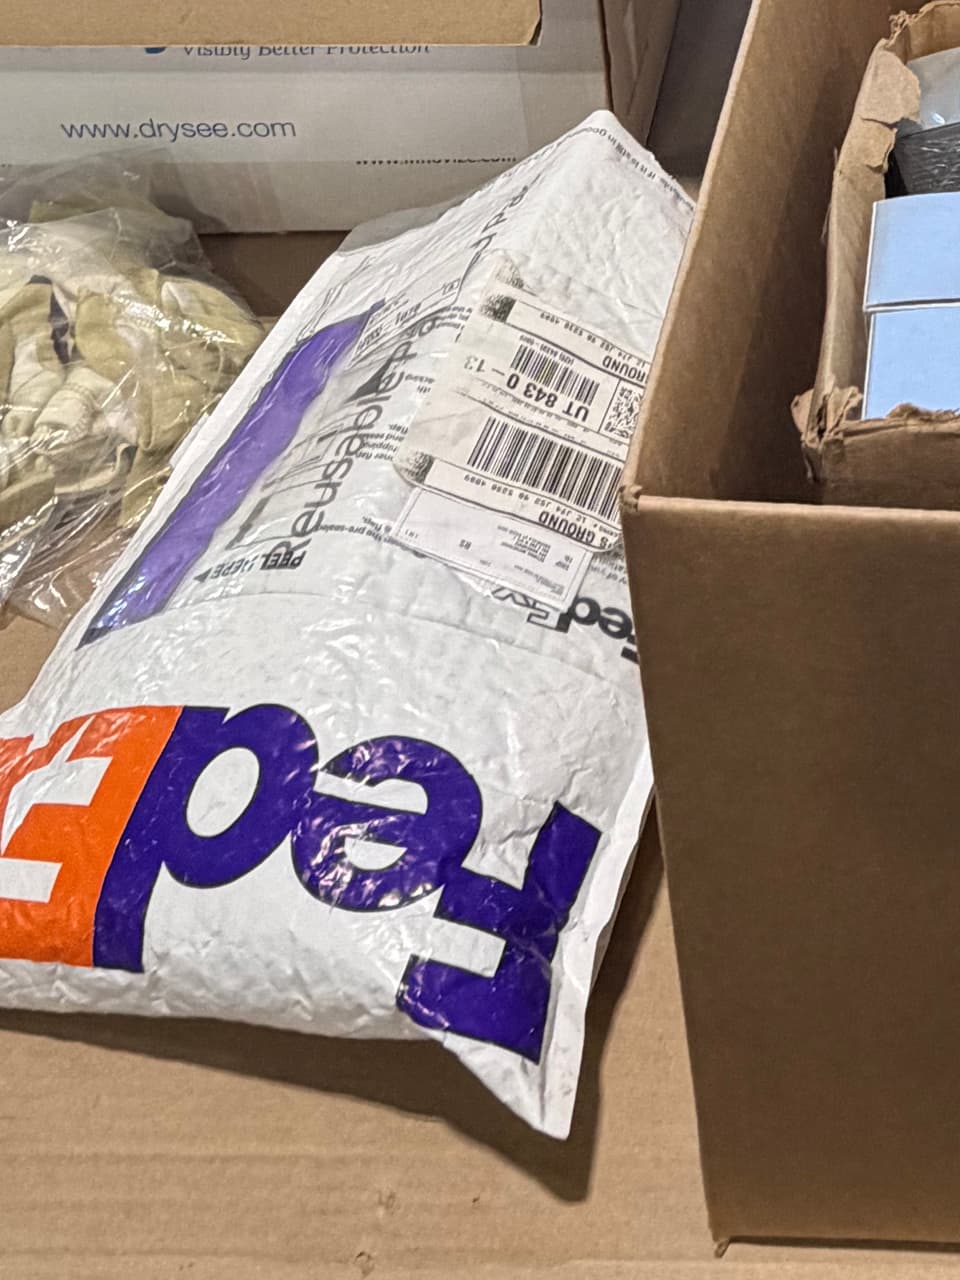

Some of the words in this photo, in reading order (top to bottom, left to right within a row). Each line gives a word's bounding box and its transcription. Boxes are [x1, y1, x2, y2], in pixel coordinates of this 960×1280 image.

[61, 118, 297, 143] www.drysee.com
[600, 354, 650, 384] ROUND
[522, 381, 559, 408] 843
[562, 399, 590, 421] UT
[536, 509, 596, 544] GROUND
[260, 548, 305, 571] PEEL
[0, 702, 602, 1066] FedE
